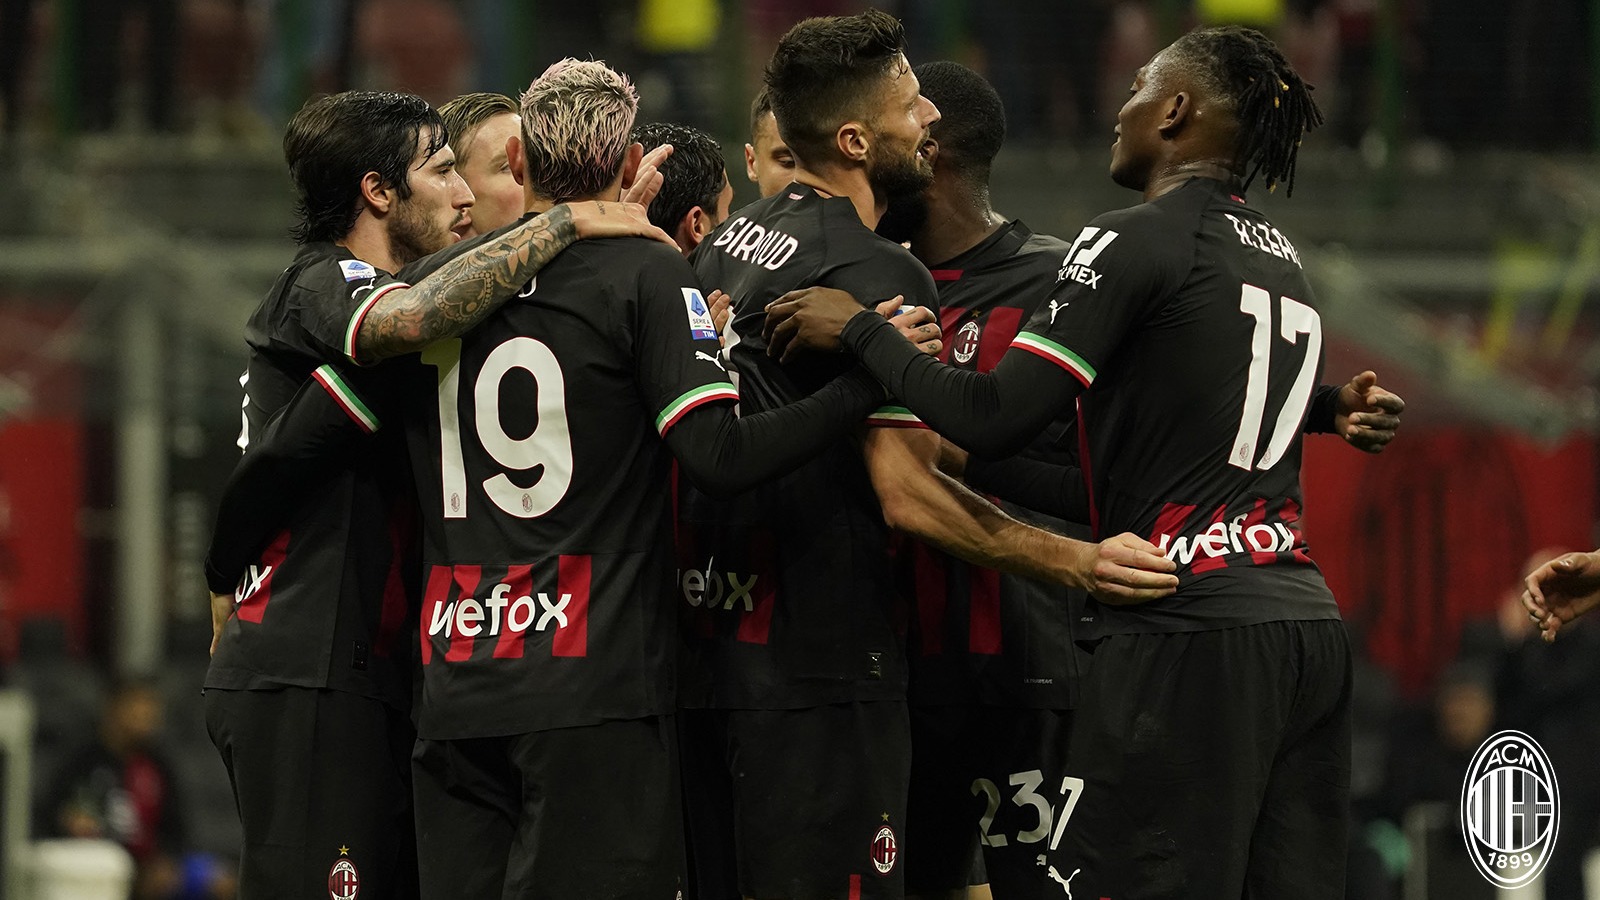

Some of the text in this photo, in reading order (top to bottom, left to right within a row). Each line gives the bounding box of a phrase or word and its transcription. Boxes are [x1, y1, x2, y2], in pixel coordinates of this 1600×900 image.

[702, 330, 715, 338] TIM
[1227, 282, 1323, 473] 17
[420, 335, 575, 520] 19
[969, 768, 1052, 849] 23
